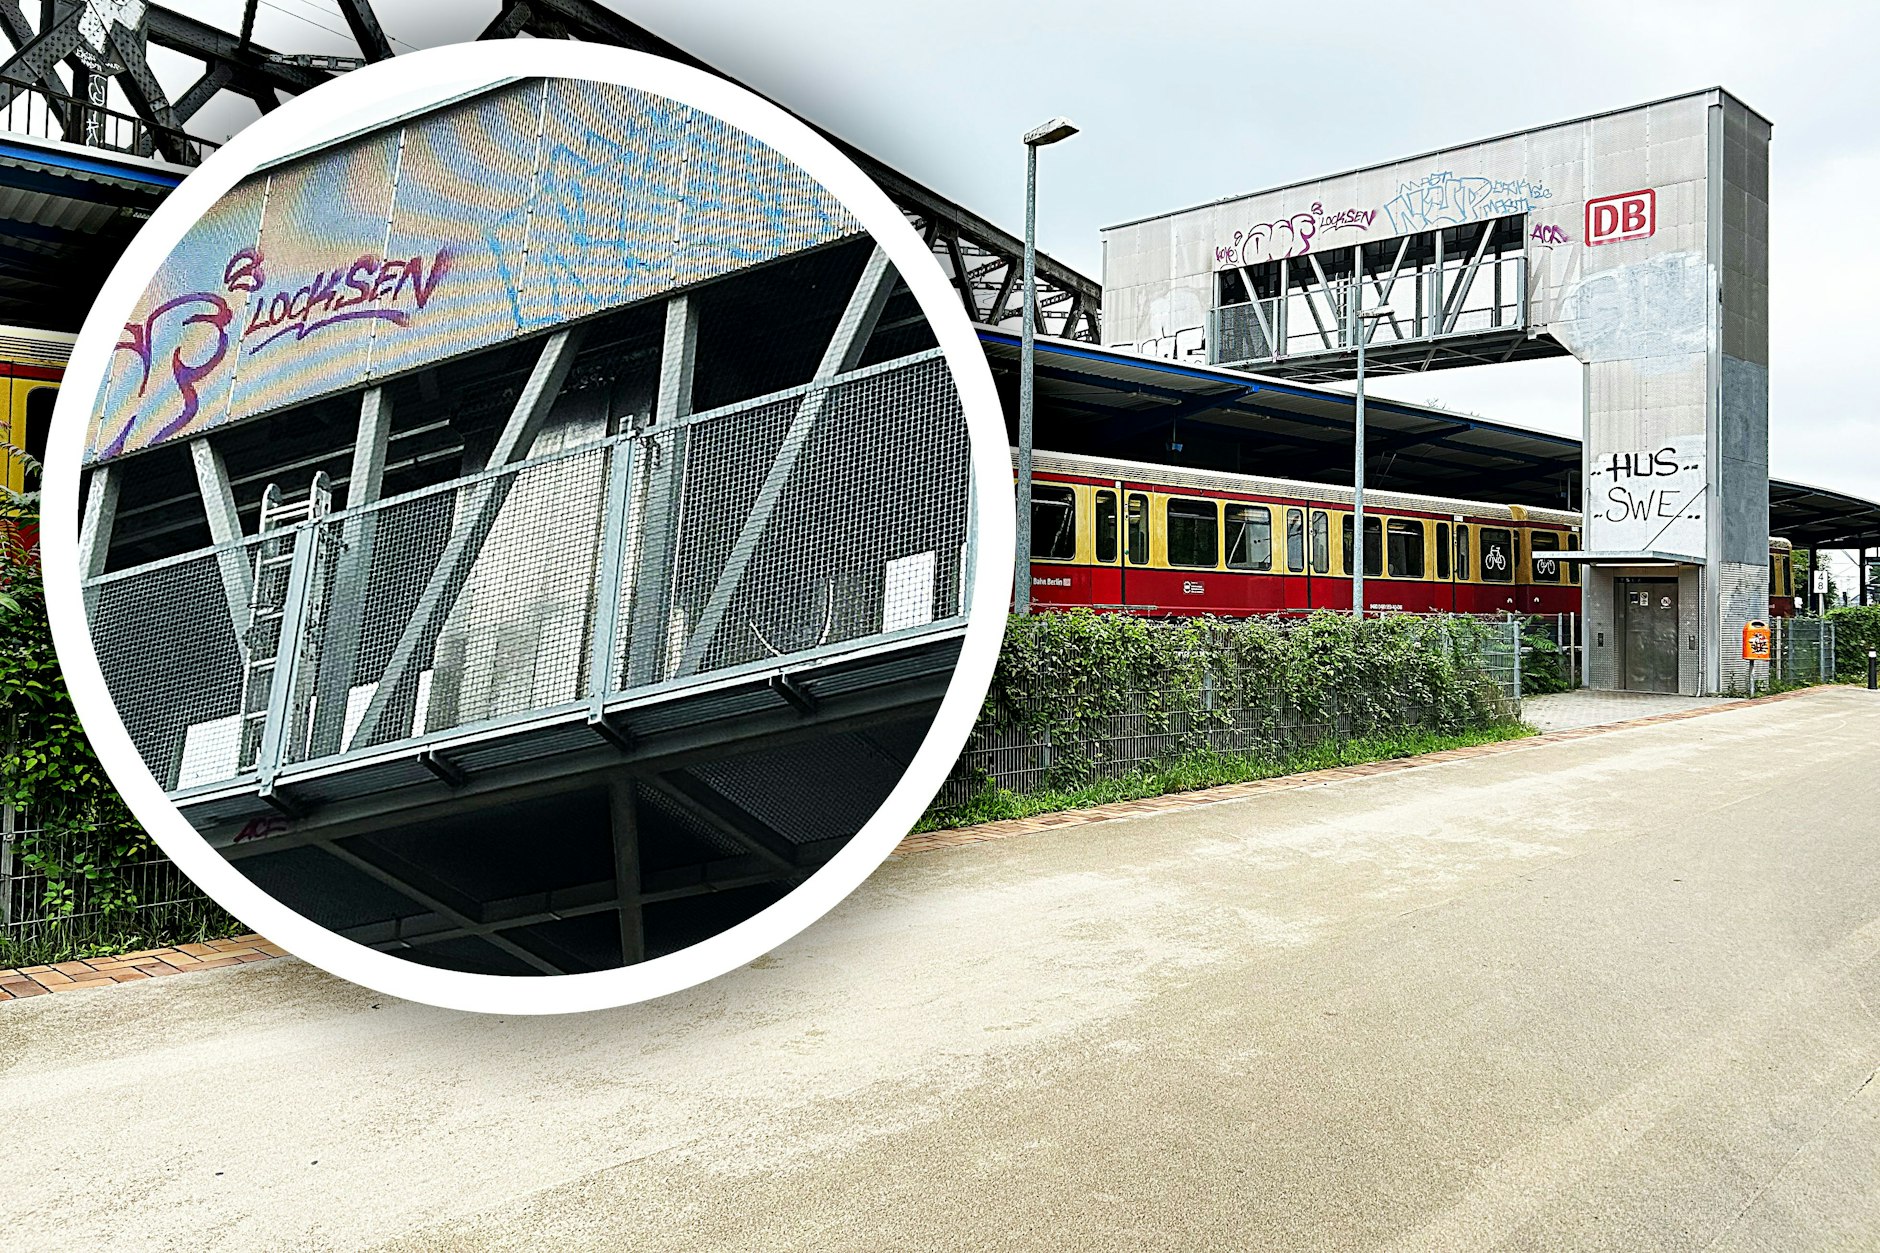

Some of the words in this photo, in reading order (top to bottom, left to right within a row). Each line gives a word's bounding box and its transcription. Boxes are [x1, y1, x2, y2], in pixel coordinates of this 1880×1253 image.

[1594, 199, 1646, 237] DB
[1606, 447, 1678, 482] HUS
[1606, 486, 1682, 522] SWE
[1033, 577, 1046, 585] Bahn
[1047, 577, 1063, 586] Berlin
[1817, 581, 1824, 590] 8
[1818, 571, 1824, 580] 4
